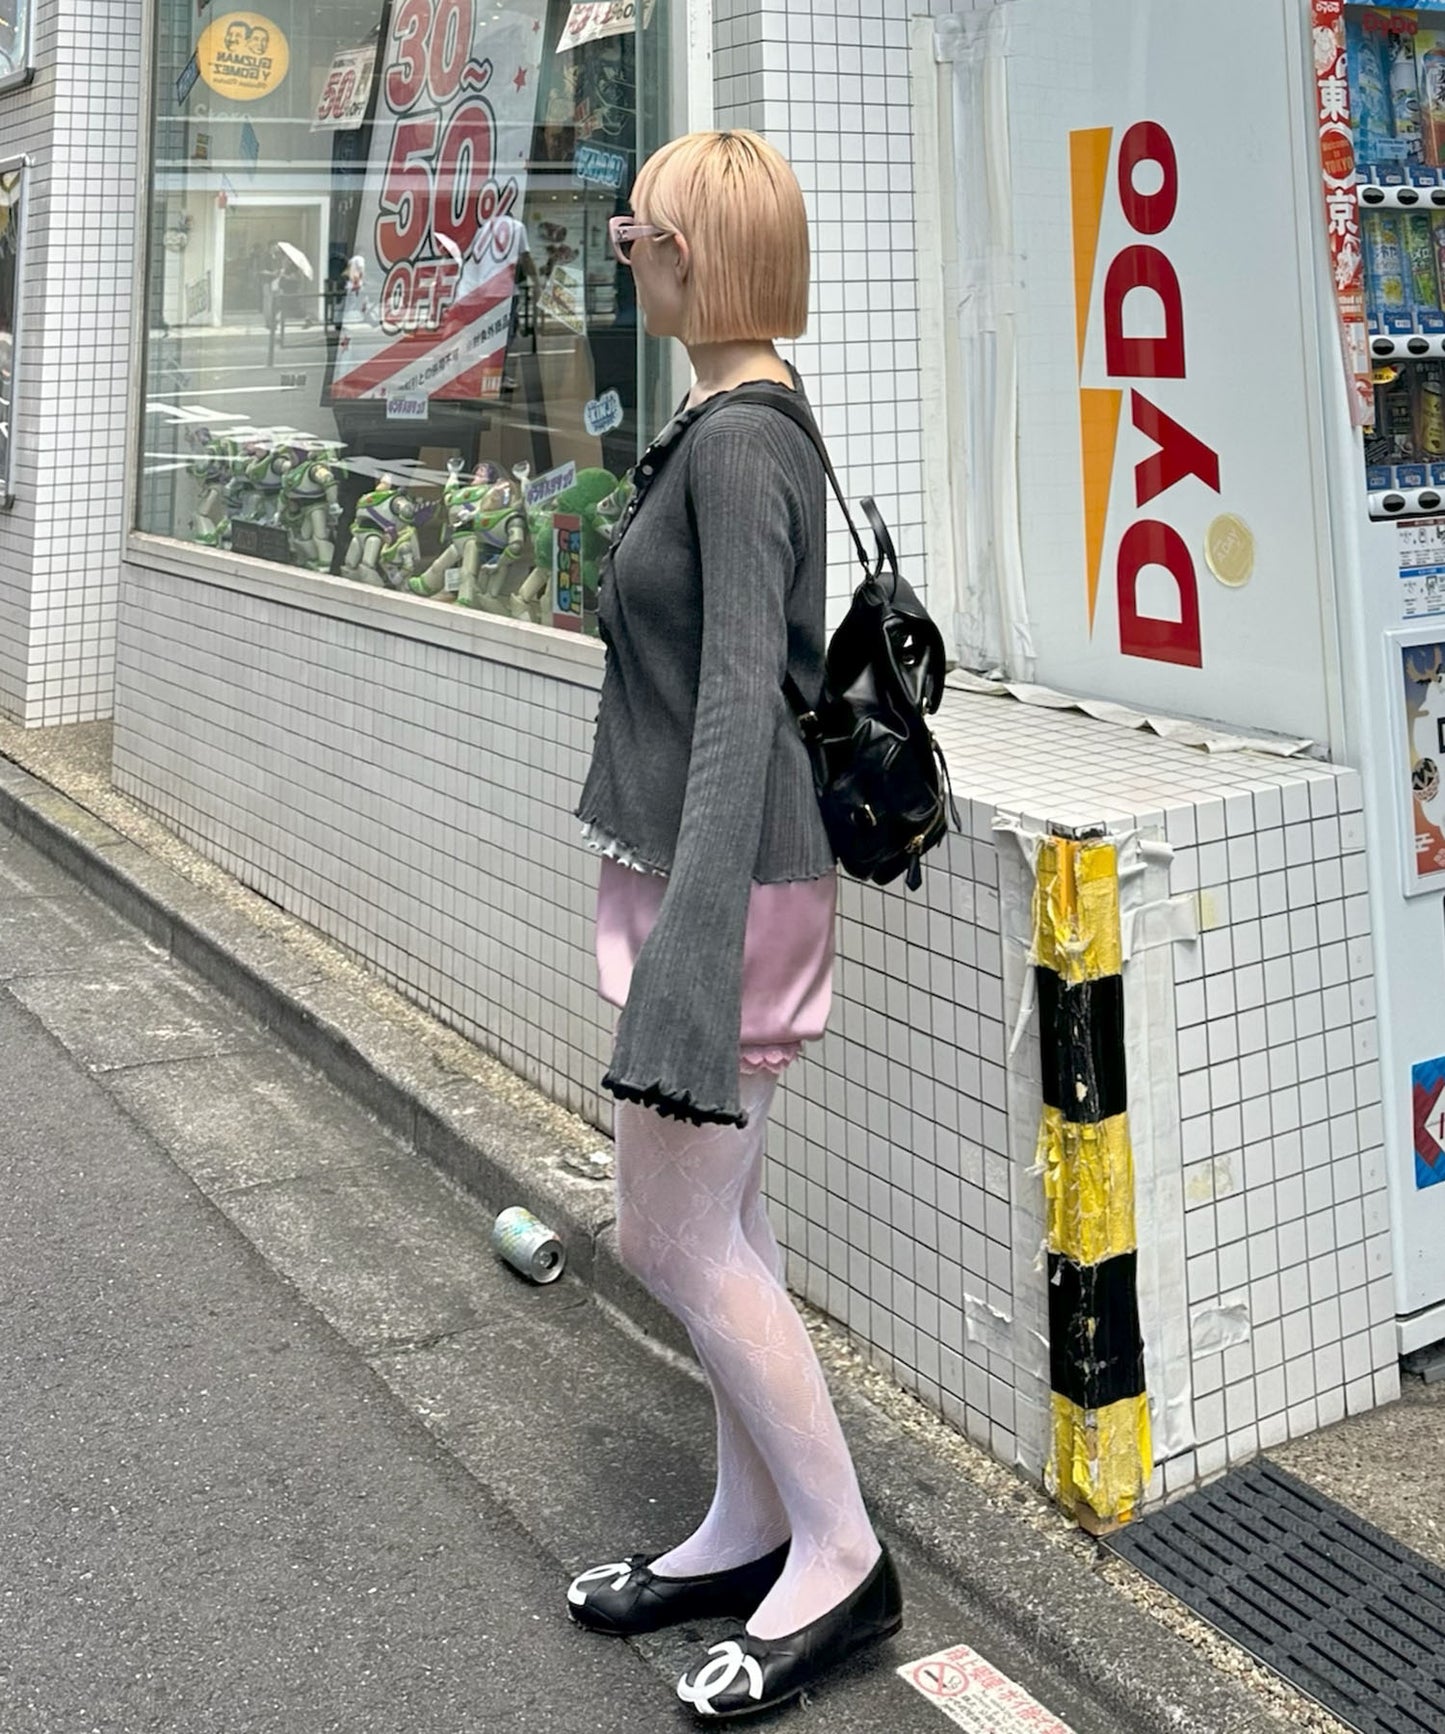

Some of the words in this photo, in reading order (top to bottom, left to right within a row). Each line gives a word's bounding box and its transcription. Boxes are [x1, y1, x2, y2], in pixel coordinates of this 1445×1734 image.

[1362, 12, 1418, 37] DyDo
[375, 95, 518, 273] 50%
[381, 259, 463, 335] OFF
[1103, 120, 1221, 669] DyDo
